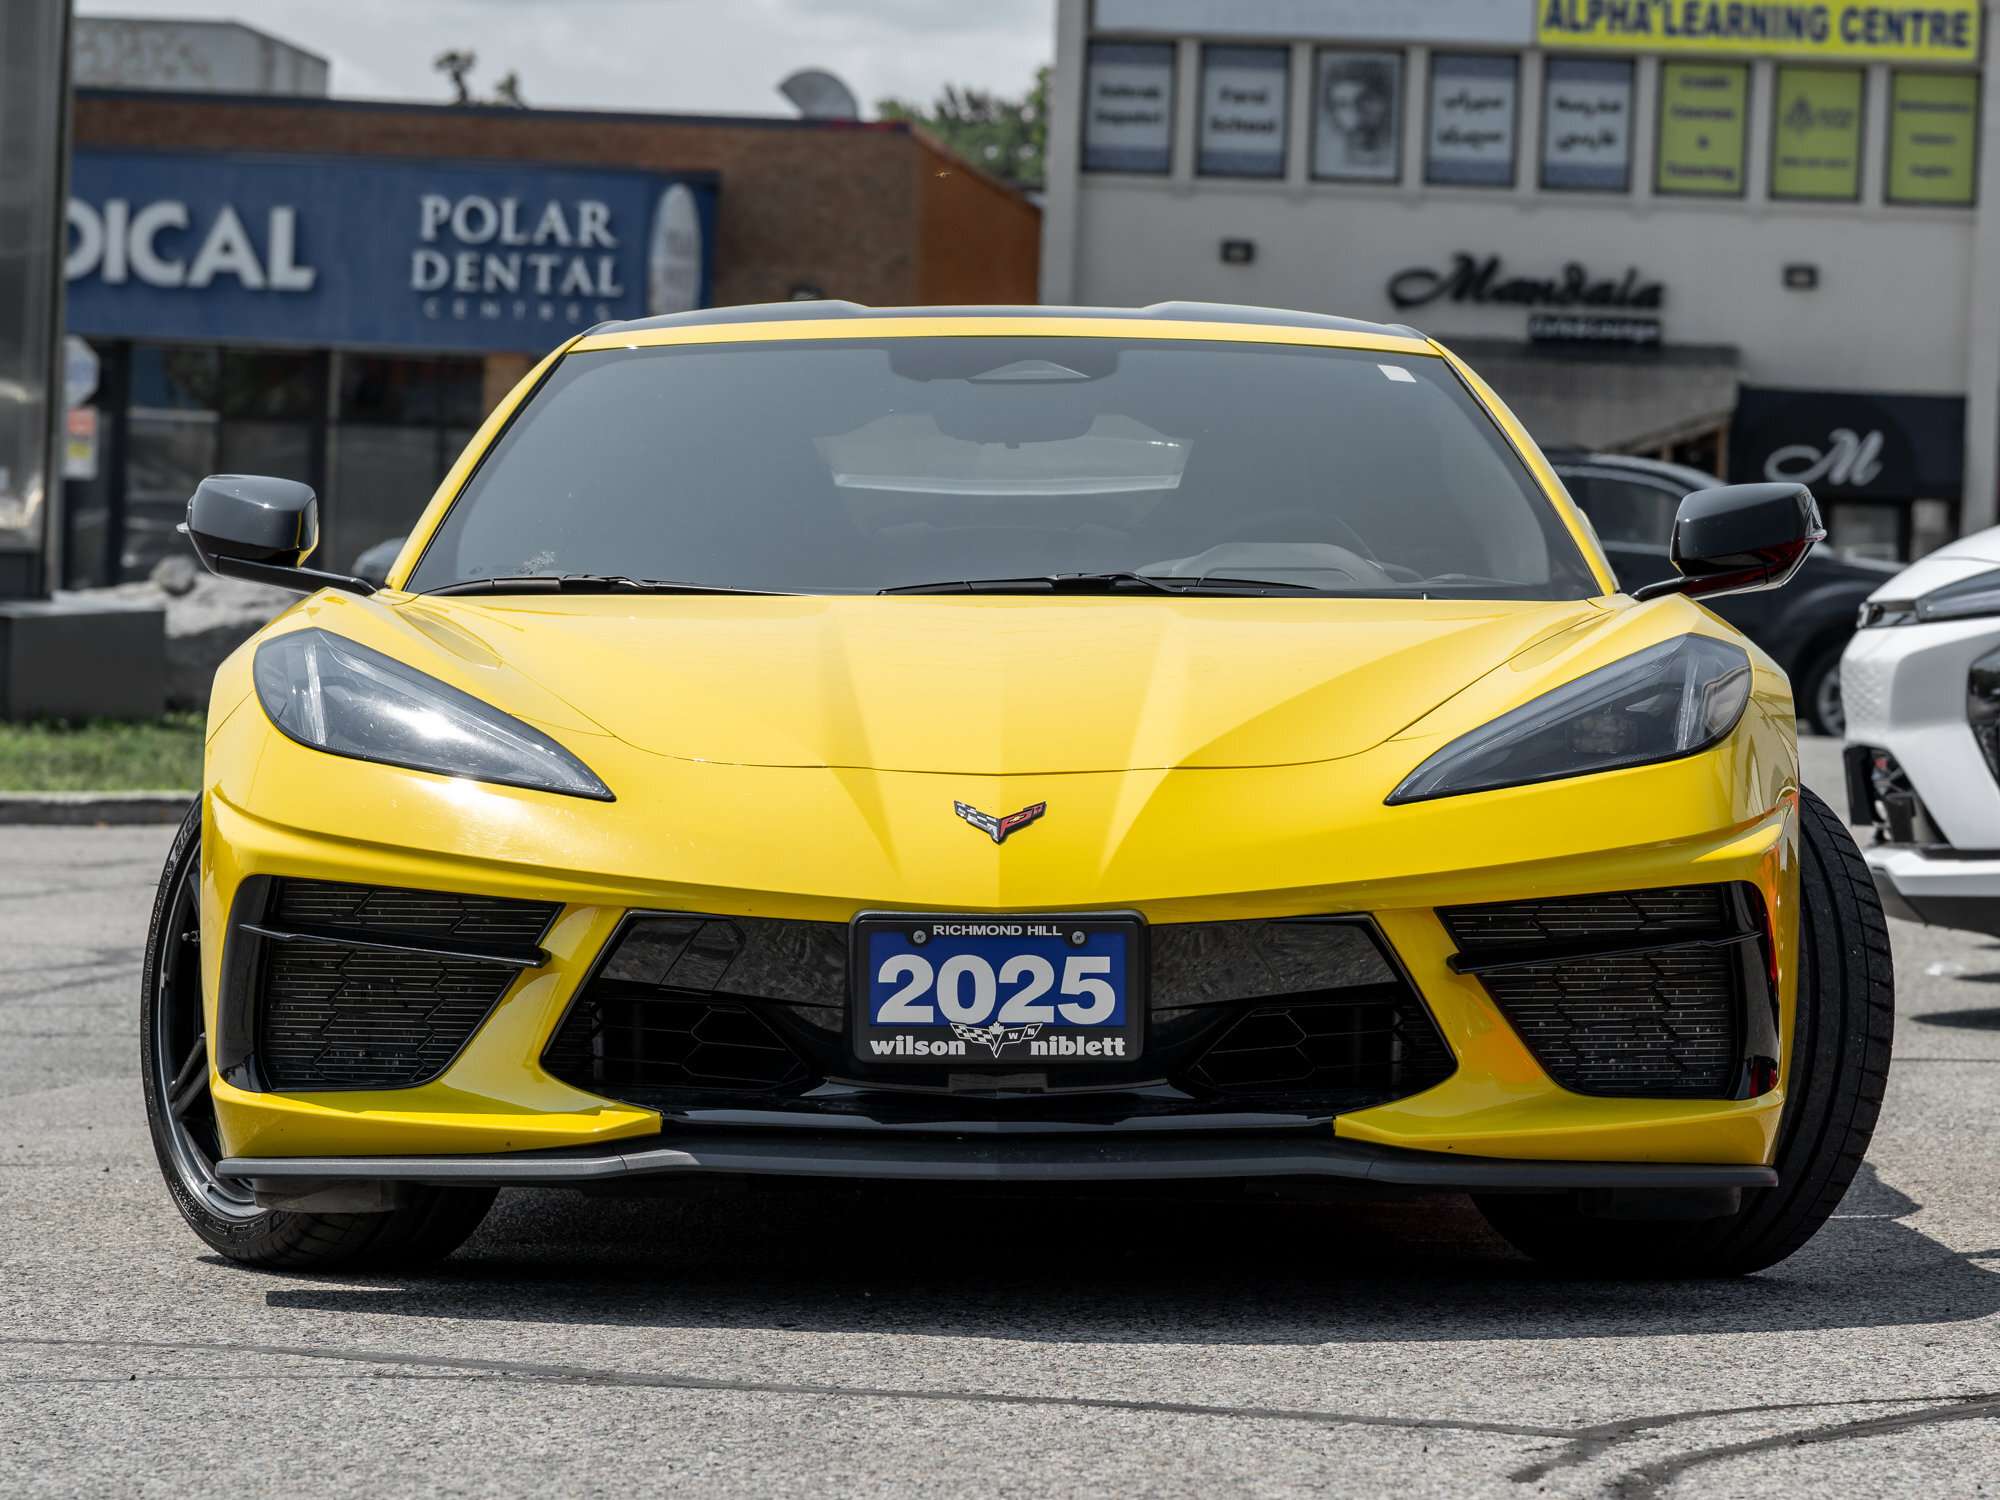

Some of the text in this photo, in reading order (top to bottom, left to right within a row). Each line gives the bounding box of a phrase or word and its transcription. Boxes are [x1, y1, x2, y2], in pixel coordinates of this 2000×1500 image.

[1662, 0, 1829, 42] LEARNING
[1840, 5, 1970, 48] CENTRE
[420, 194, 618, 249] POLAR
[411, 249, 624, 298] DENTAL
[932, 924, 1064, 936] RICHMOND HILL
[876, 953, 1117, 1025] 2025
[869, 1036, 1127, 1057] wilson niblett
